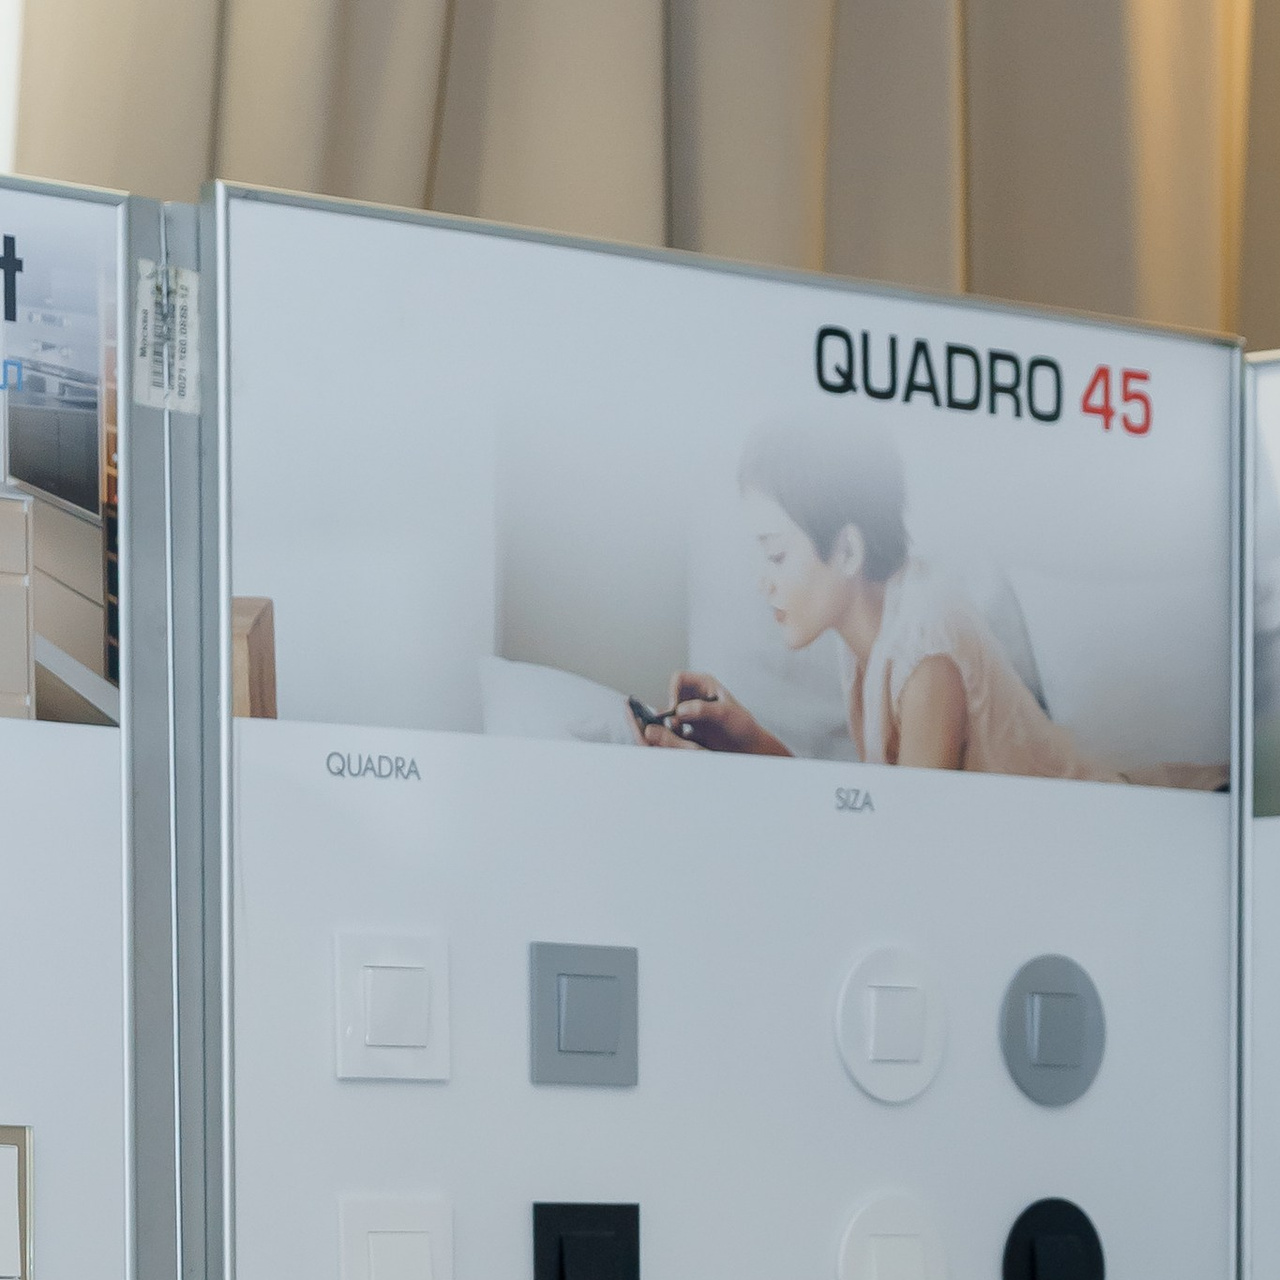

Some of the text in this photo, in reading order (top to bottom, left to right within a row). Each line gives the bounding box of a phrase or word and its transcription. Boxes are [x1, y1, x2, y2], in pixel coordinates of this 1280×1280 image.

[814, 324, 1154, 436] QUADRO 45
[326, 751, 421, 781] QUADRA
[835, 787, 876, 812] SIZA
